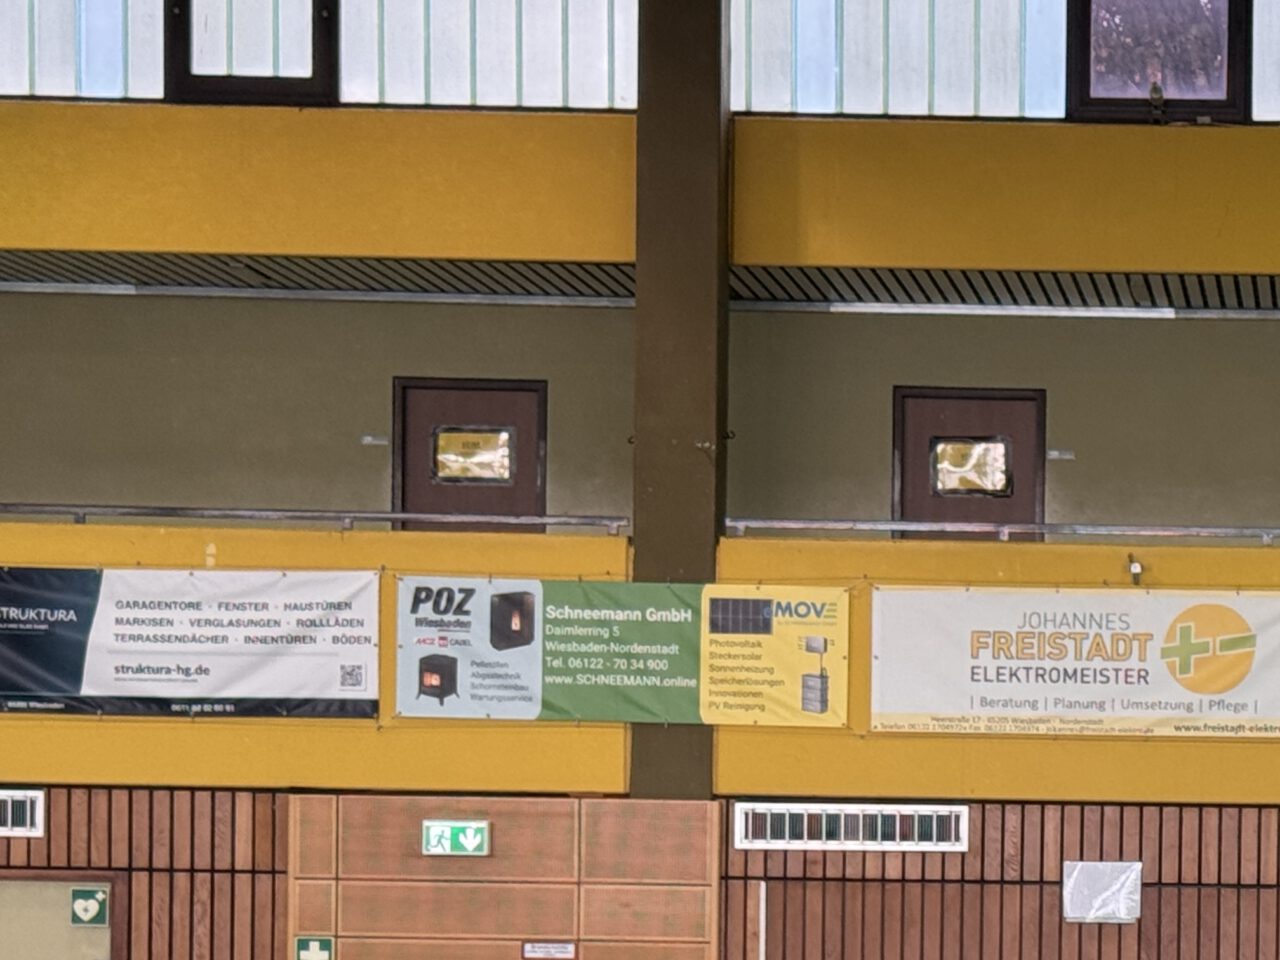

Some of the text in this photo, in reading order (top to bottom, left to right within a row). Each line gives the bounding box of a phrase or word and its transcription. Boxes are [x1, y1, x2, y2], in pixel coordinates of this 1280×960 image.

[114, 599, 353, 612] GARAGENTORE FENSTER HAUSTÜREN
[410, 586, 476, 616] POZ
[545, 605, 693, 623] Schneemann GmbH
[1017, 611, 1131, 631] JOHANNES
[114, 617, 174, 628] MARKISEN
[188, 617, 282, 628] VERGLASUNGEN
[415, 617, 472, 629] Wiesbaden
[113, 632, 372, 645] TERRASSENDÄCHER INNENTÜREN BÖDEN
[545, 624, 620, 640] Daimlerring 5
[545, 641, 680, 655] Wiesbaden-Nordenstadt
[708, 639, 763, 649] Photovoltaik
[969, 631, 1154, 662] FREISTADT
[113, 663, 211, 678] struktura-hg.de
[545, 657, 669, 671] Tel. 06122 70 34 900
[544, 673, 698, 688] www.SCHNEEMANN.online
[969, 665, 1151, 686] ELEKTROMEISTER
[979, 696, 1249, 714] Beratung Planung Umsetzung Pflege
